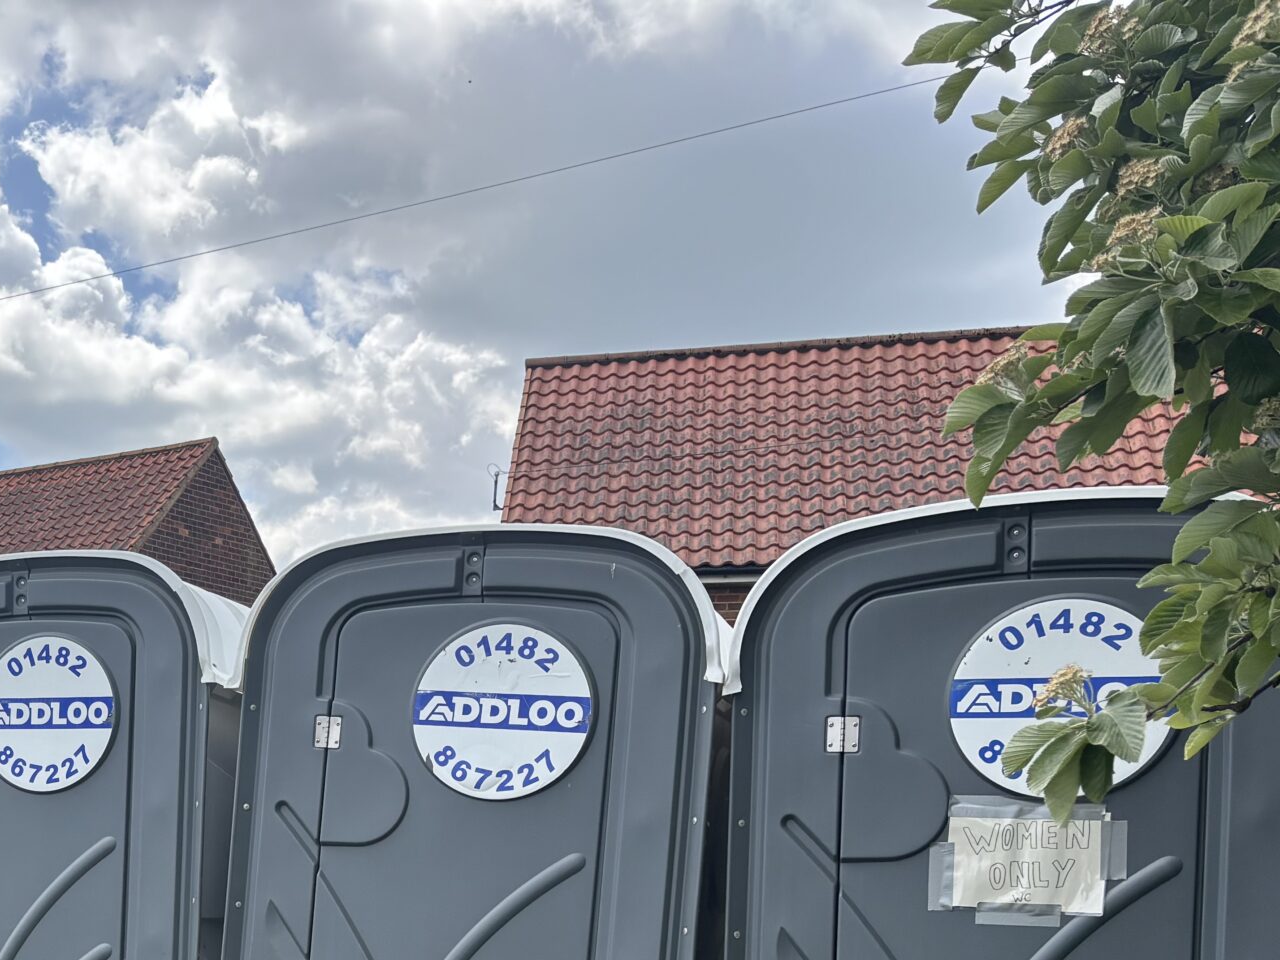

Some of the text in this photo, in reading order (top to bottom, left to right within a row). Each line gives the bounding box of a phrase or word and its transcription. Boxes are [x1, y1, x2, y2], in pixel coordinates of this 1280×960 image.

[997, 608, 1134, 651] 01482
[6, 643, 88, 678] 01482
[454, 632, 560, 673] 01482
[418, 695, 584, 728] ADDLOO
[433, 745, 556, 792] 867227
[963, 819, 1091, 855] WOMEN
[988, 859, 1076, 891] ONLY
[1011, 892, 1032, 903] WC
